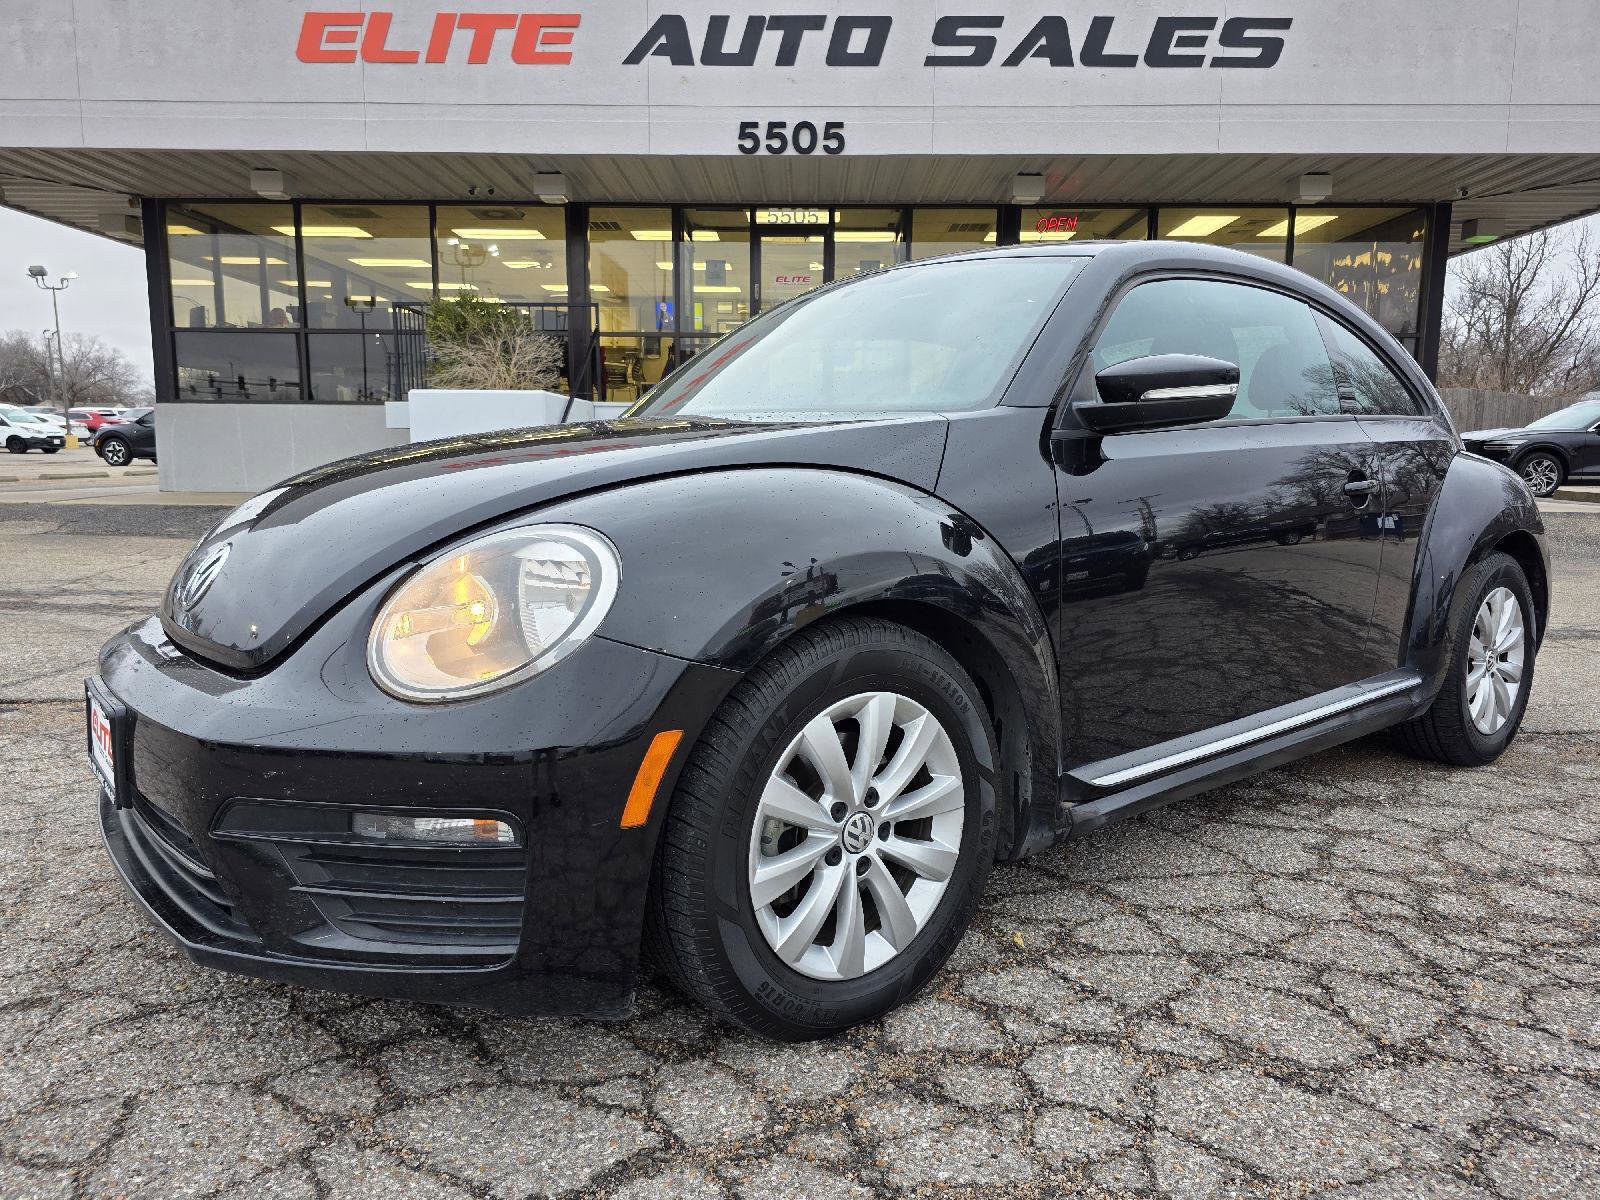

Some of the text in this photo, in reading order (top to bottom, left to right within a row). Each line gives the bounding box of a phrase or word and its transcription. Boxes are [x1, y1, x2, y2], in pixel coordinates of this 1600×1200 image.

[296, 12, 1293, 68] ELITE AUTO SALES
[737, 121, 846, 156] 5505
[767, 208, 819, 224] 5505
[1037, 216, 1079, 233] OPEN
[775, 275, 812, 283] ELITE
